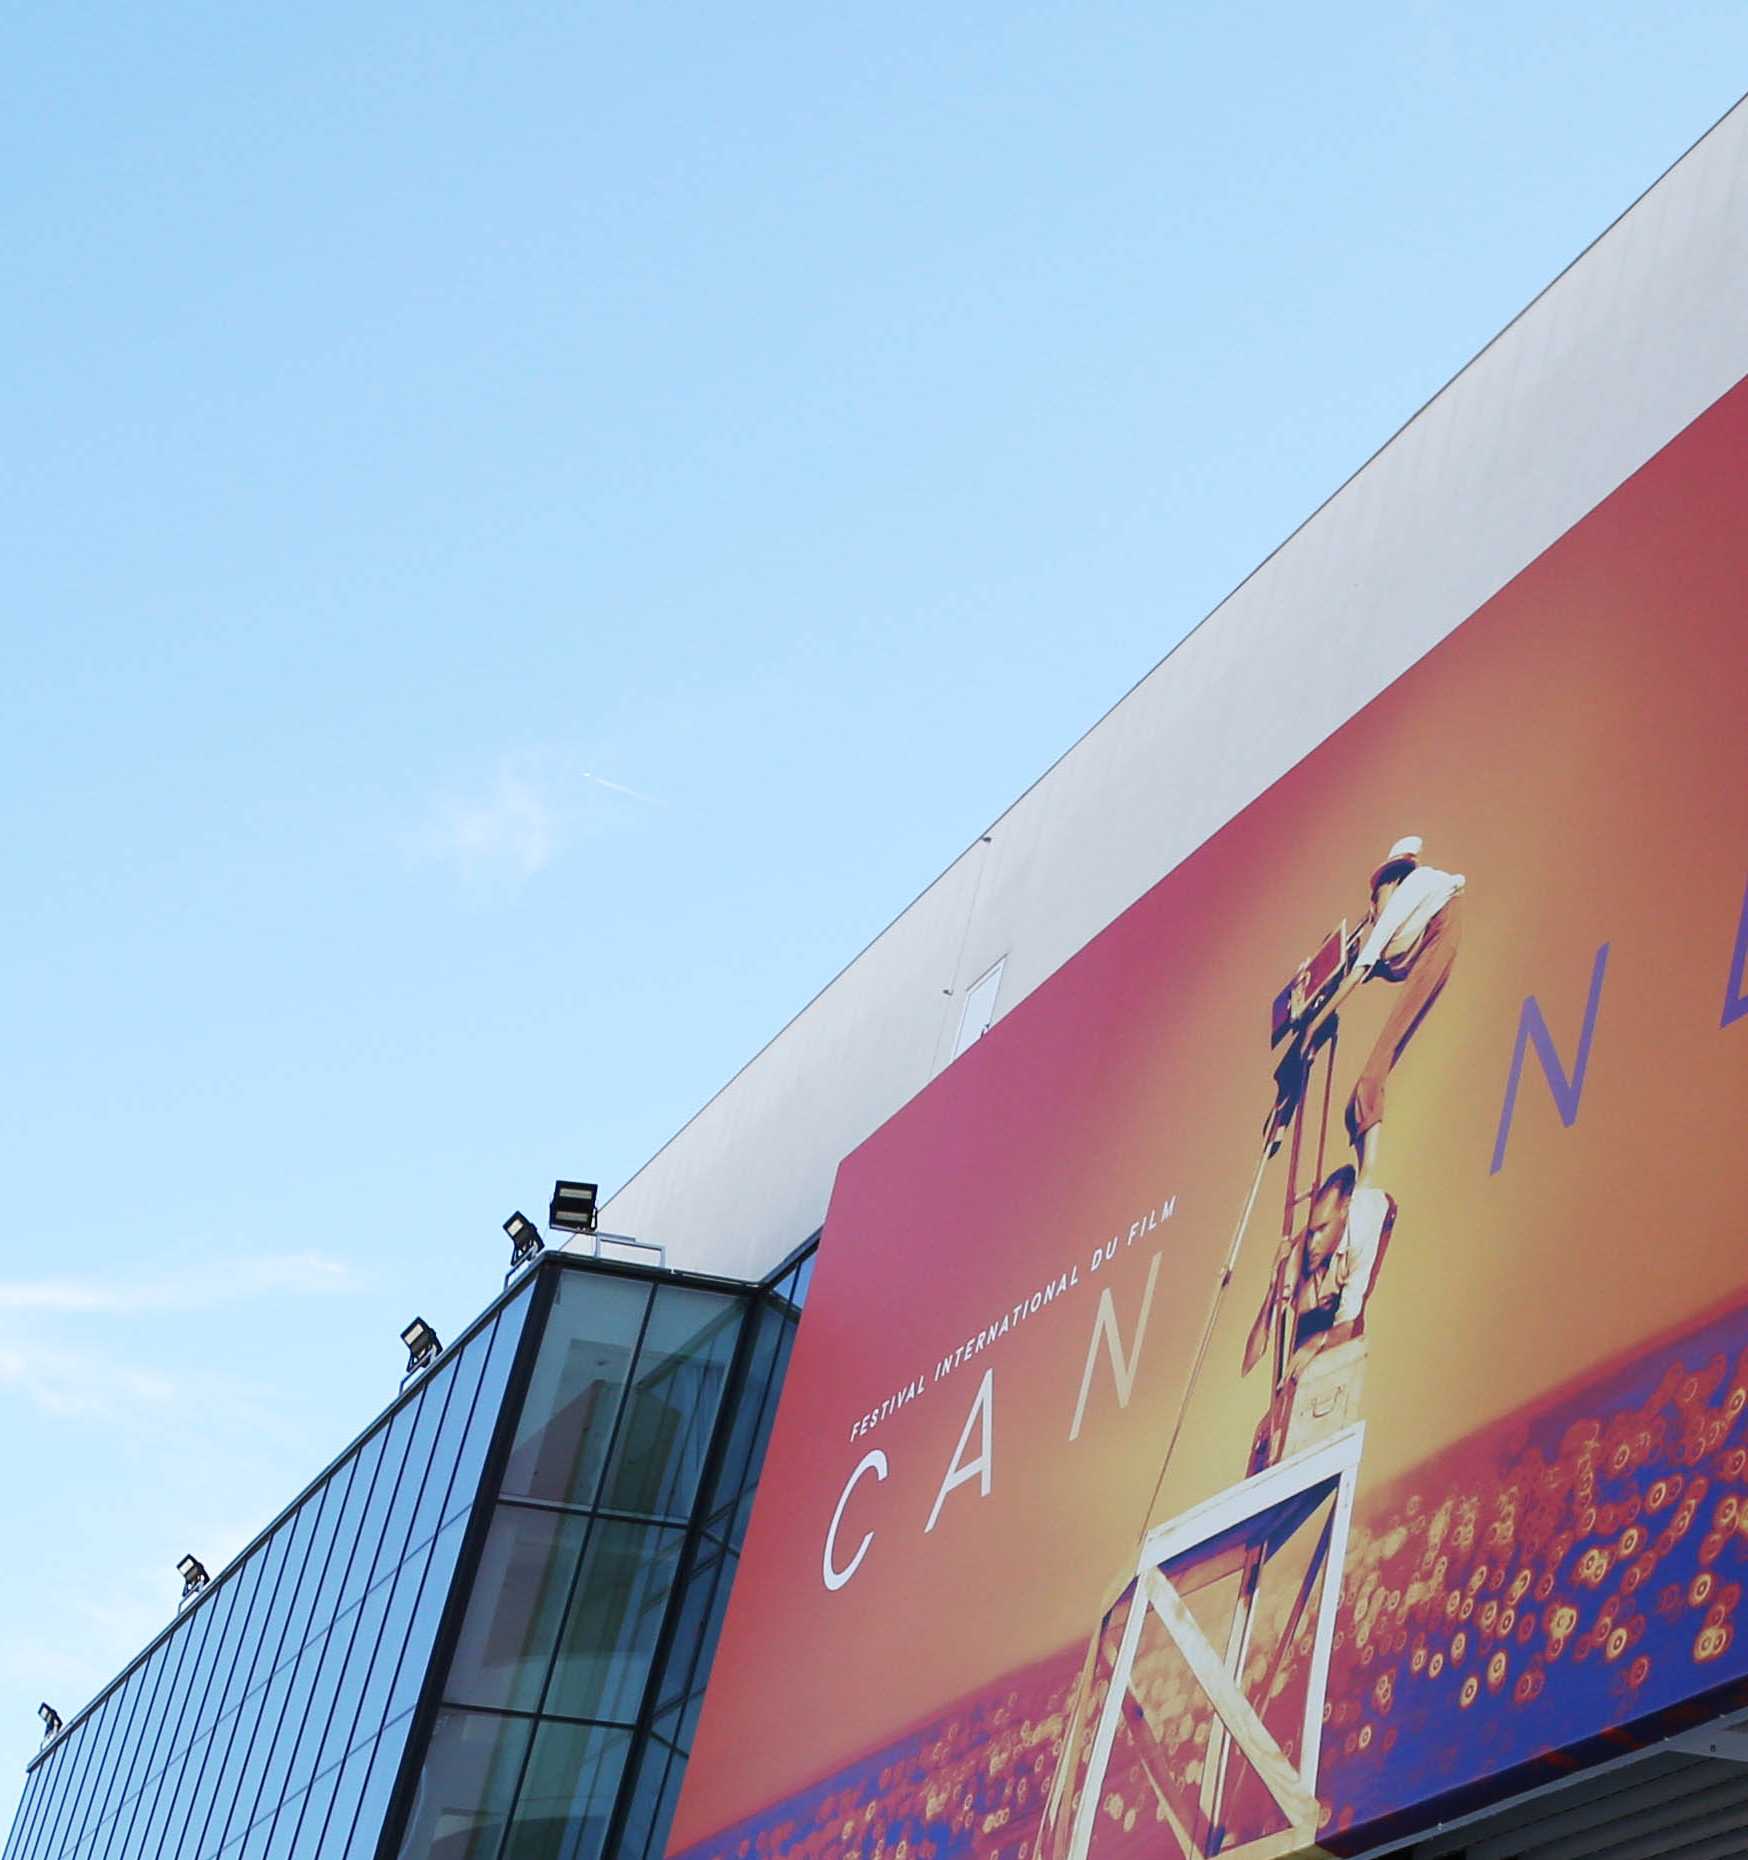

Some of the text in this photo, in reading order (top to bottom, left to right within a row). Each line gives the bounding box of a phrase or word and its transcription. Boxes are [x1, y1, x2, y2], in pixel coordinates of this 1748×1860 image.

[849, 1194, 1177, 1443] FESTIVAL INTERNATIONAL DU FILM
